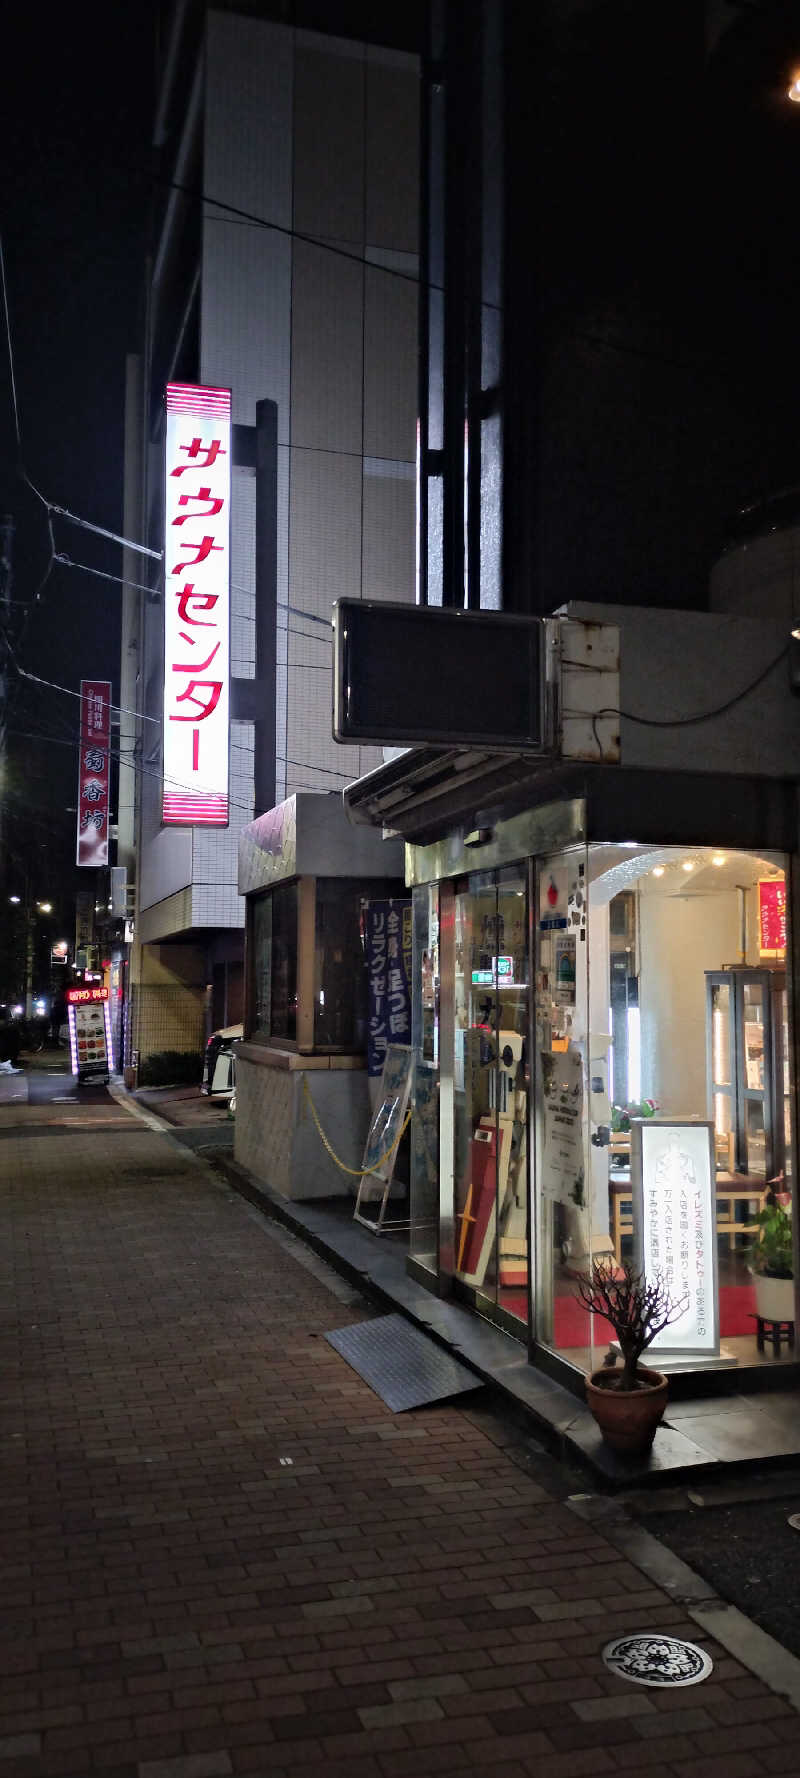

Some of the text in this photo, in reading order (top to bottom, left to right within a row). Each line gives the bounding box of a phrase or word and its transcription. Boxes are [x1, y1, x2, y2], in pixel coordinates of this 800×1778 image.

[169, 437, 227, 771] サウナセンター
